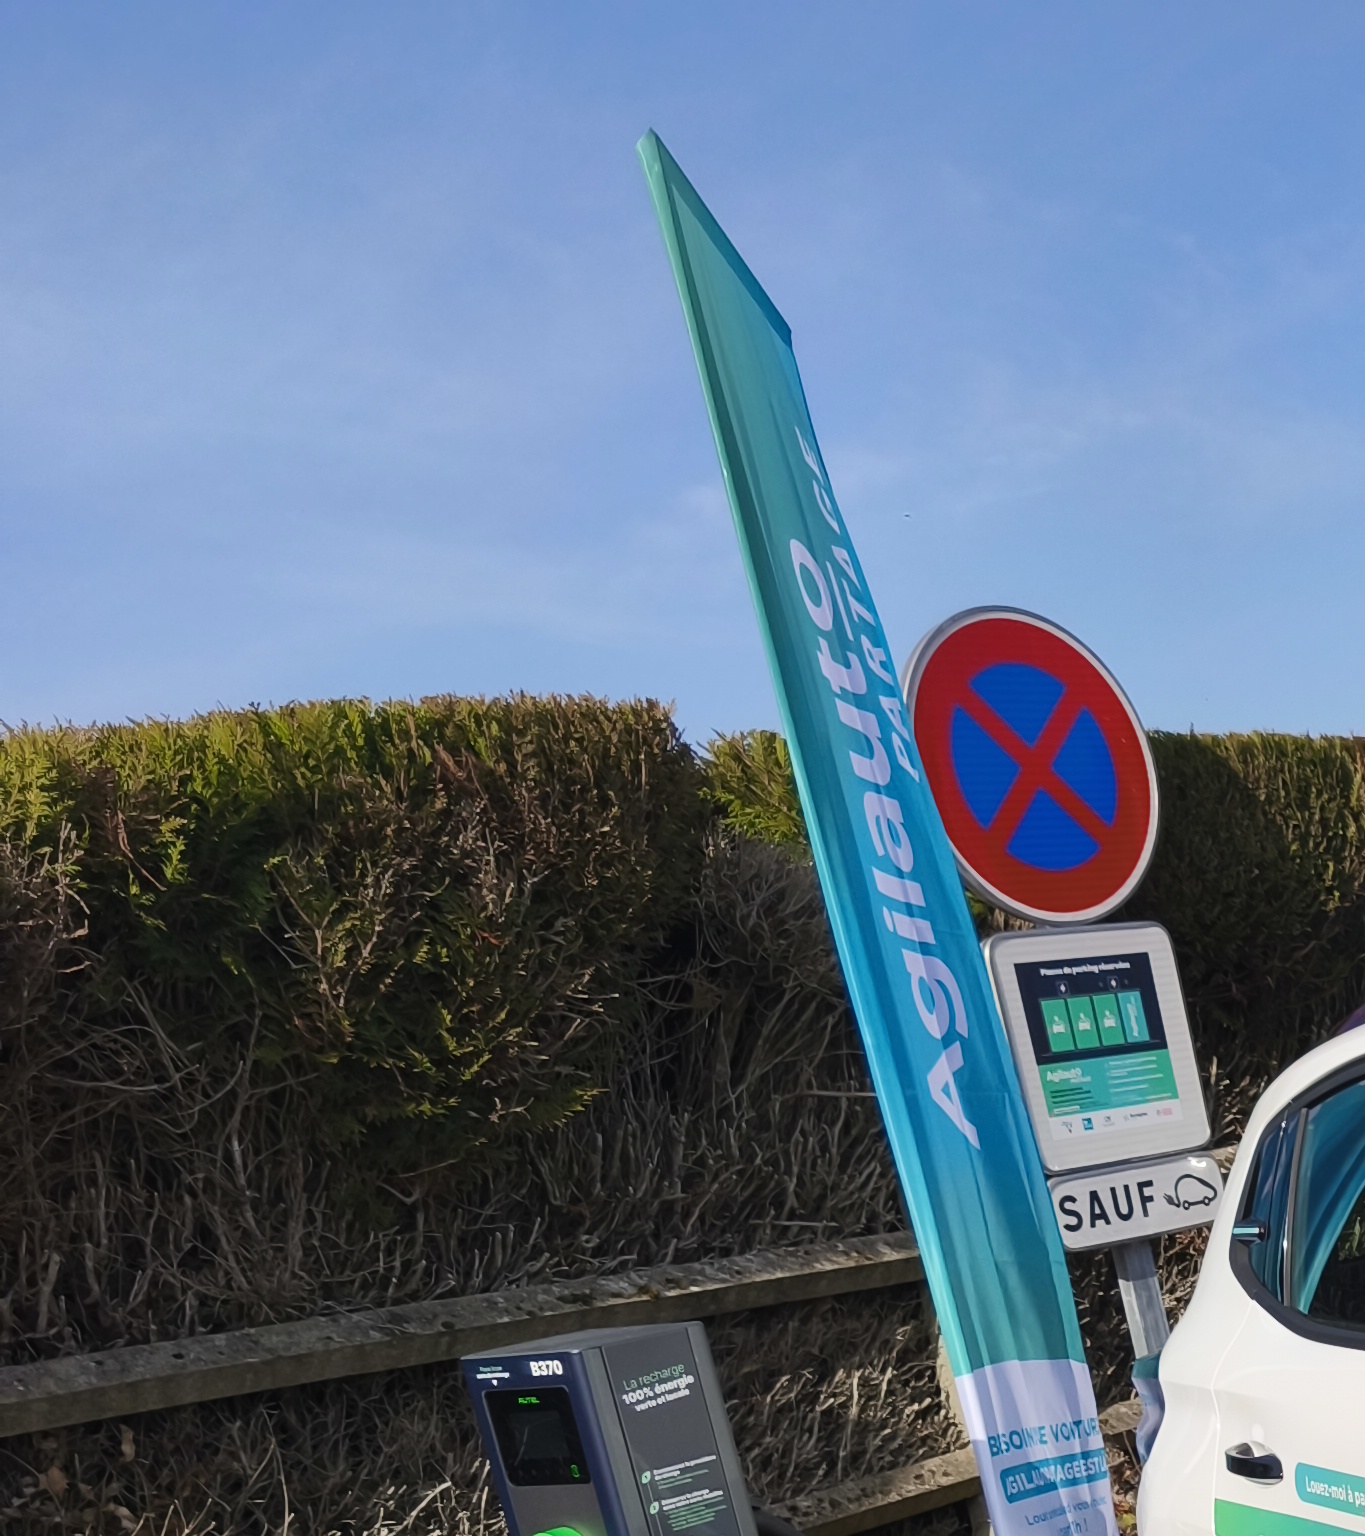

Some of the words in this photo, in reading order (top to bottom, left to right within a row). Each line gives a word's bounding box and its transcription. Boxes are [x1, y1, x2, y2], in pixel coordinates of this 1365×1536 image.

[1058, 1179, 1155, 1232] SAUF
[529, 1359, 563, 1377] B370
[623, 1379, 638, 1391] La
[639, 1364, 685, 1386] recharge
[622, 1387, 654, 1405] 100%
